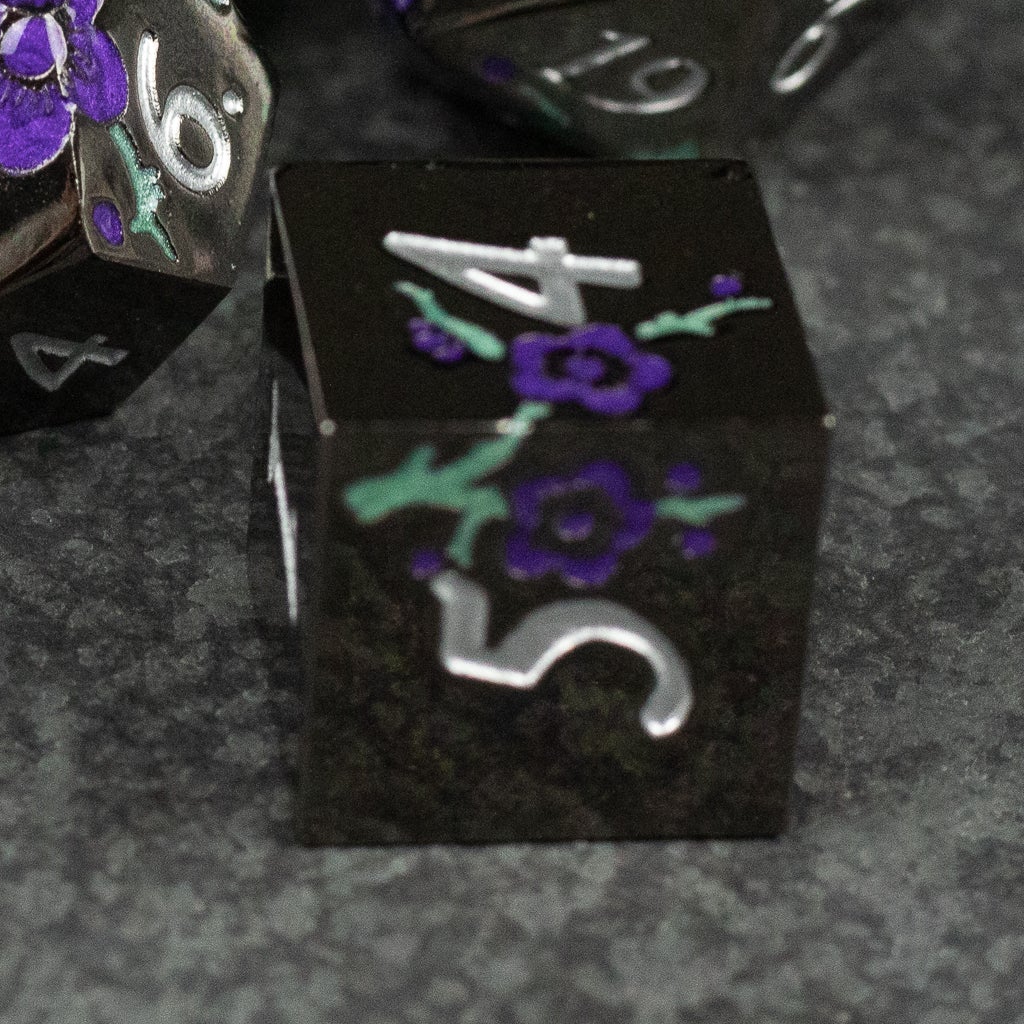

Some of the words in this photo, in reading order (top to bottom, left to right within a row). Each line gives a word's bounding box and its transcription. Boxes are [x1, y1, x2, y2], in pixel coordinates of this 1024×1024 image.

[383, 230, 643, 327] 4
[10, 332, 130, 392] 4
[430, 569, 693, 738] 5
